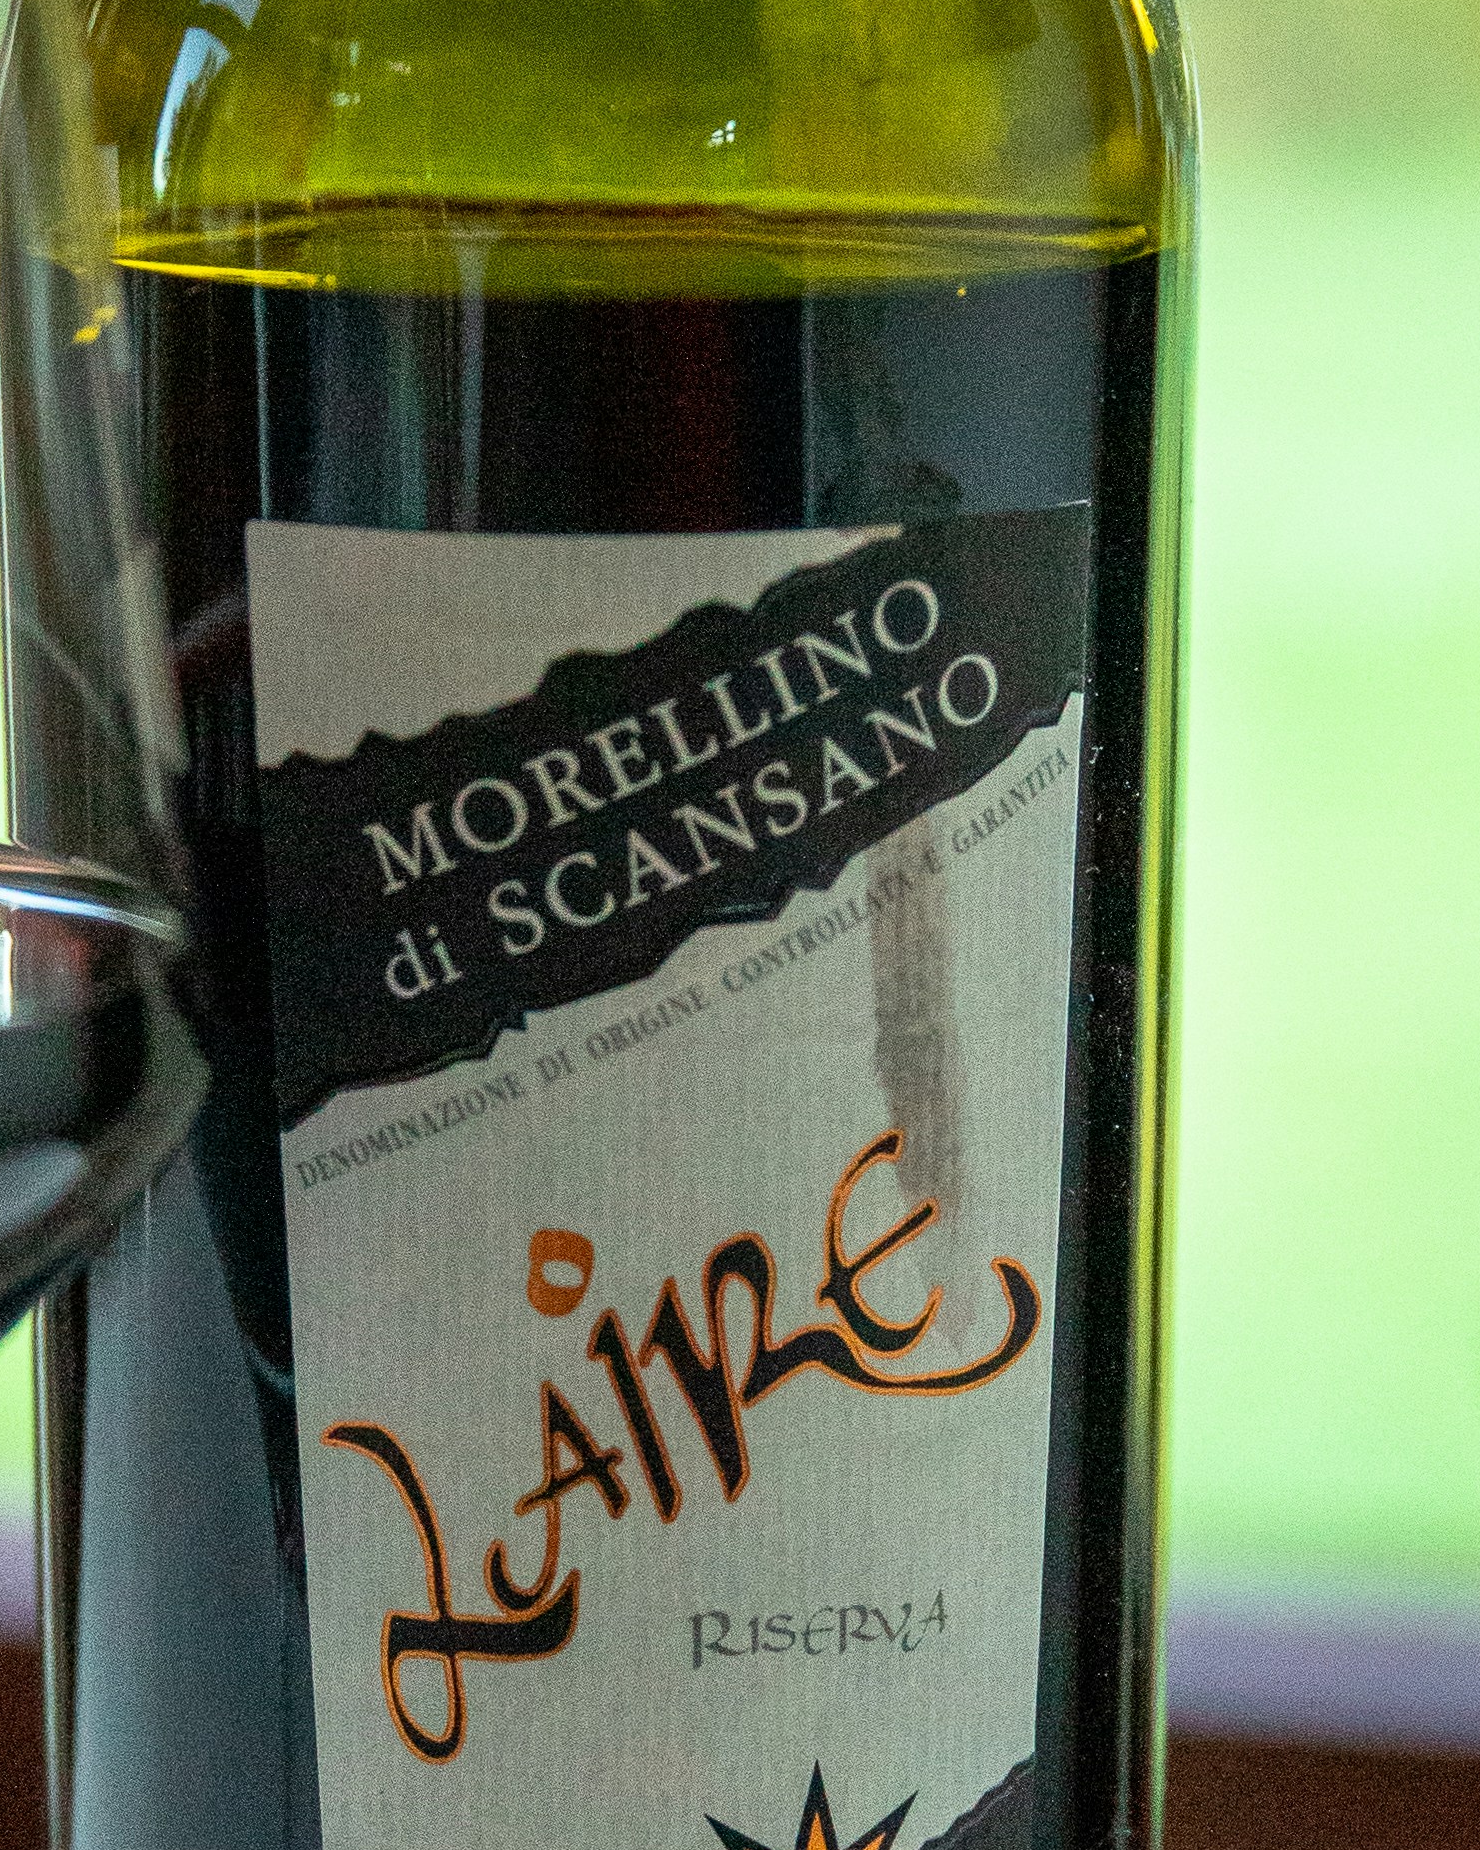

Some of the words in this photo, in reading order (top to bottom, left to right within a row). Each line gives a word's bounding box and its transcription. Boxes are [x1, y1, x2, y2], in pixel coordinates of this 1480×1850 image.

[363, 579, 939, 896] MORELLINO
[385, 927, 461, 1000] di
[487, 654, 999, 955] SCANSANO
[295, 1074, 524, 1193] DENOMINAZIONE
[538, 1047, 576, 1086] DI
[586, 992, 710, 1062] ORIGINE
[721, 867, 914, 996] CONTROLLATA
